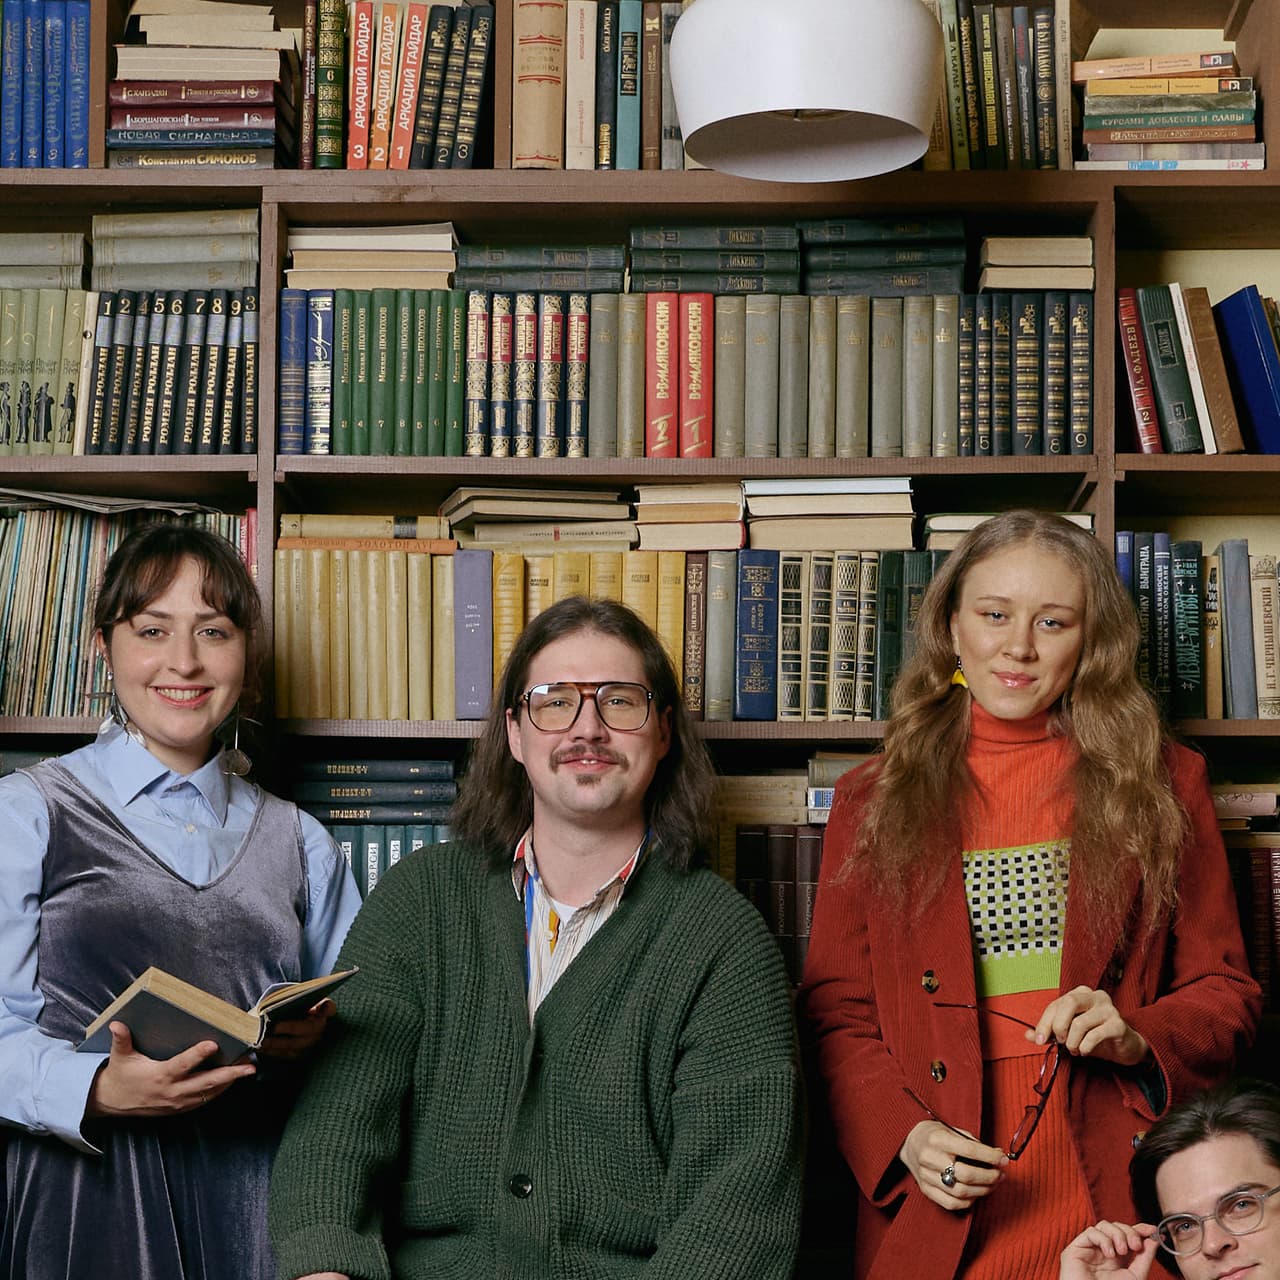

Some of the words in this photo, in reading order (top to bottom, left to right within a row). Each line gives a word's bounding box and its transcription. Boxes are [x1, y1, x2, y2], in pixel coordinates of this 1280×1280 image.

[357, 12, 371, 63] ГАЙДАР
[380, 15, 395, 66] ГАЙДАР
[406, 15, 420, 65] ГАЙДАР
[355, 67, 369, 129] АРКАДИЙ
[376, 69, 391, 131] АРКАДИЙ
[398, 68, 416, 131] АРКАДИЙ
[1201, 114, 1208, 124] И
[1212, 113, 1245, 123] СЛАВЫ
[118, 131, 161, 140] НОВАЯ
[352, 144, 364, 159] 3
[373, 147, 385, 161] 2
[396, 146, 404, 159] 1
[437, 148, 449, 163] 2
[457, 144, 468, 159] 3
[197, 154, 257, 165] СИМОНОВ
[104, 301, 112, 315] 1
[120, 298, 130, 313] 2
[138, 299, 148, 314] 4
[153, 298, 165, 313] 5
[171, 300, 182, 314] 6
[196, 299, 205, 313] 7
[212, 298, 222, 313] 8
[231, 300, 241, 315] 9
[245, 296, 256, 311] 3
[96, 347, 108, 397] РОЛЛАН
[113, 346, 125, 395] РОЛЛАН
[132, 347, 144, 396] РОЛЛАН
[147, 345, 160, 394] РОЛЛАН
[188, 345, 200, 395] РОЛЛАН
[207, 346, 218, 395] РОЛЛАН
[225, 348, 237, 397] РОЛЛАН
[246, 344, 255, 393] РОЛЛАН
[159, 399, 171, 445] РОМЕН
[165, 347, 176, 396] РОЛЛАН
[91, 400, 103, 445] РОМЕН
[109, 398, 120, 443] РОМЕН
[127, 400, 138, 445] РОМЕН
[142, 398, 154, 442] РОМЕН
[183, 398, 195, 444] РОМЕН
[202, 399, 213, 444] РОМЕН
[222, 400, 233, 445] РОМЕН
[245, 398, 254, 443] РОМЕН
[656, 420, 668, 441] 2
[1023, 434, 1033, 448] 7
[1075, 433, 1087, 447] 9
[979, 435, 990, 450] 5
[1049, 438, 1061, 453] 8
[1140, 545, 1149, 590] ВЫИГРАНА
